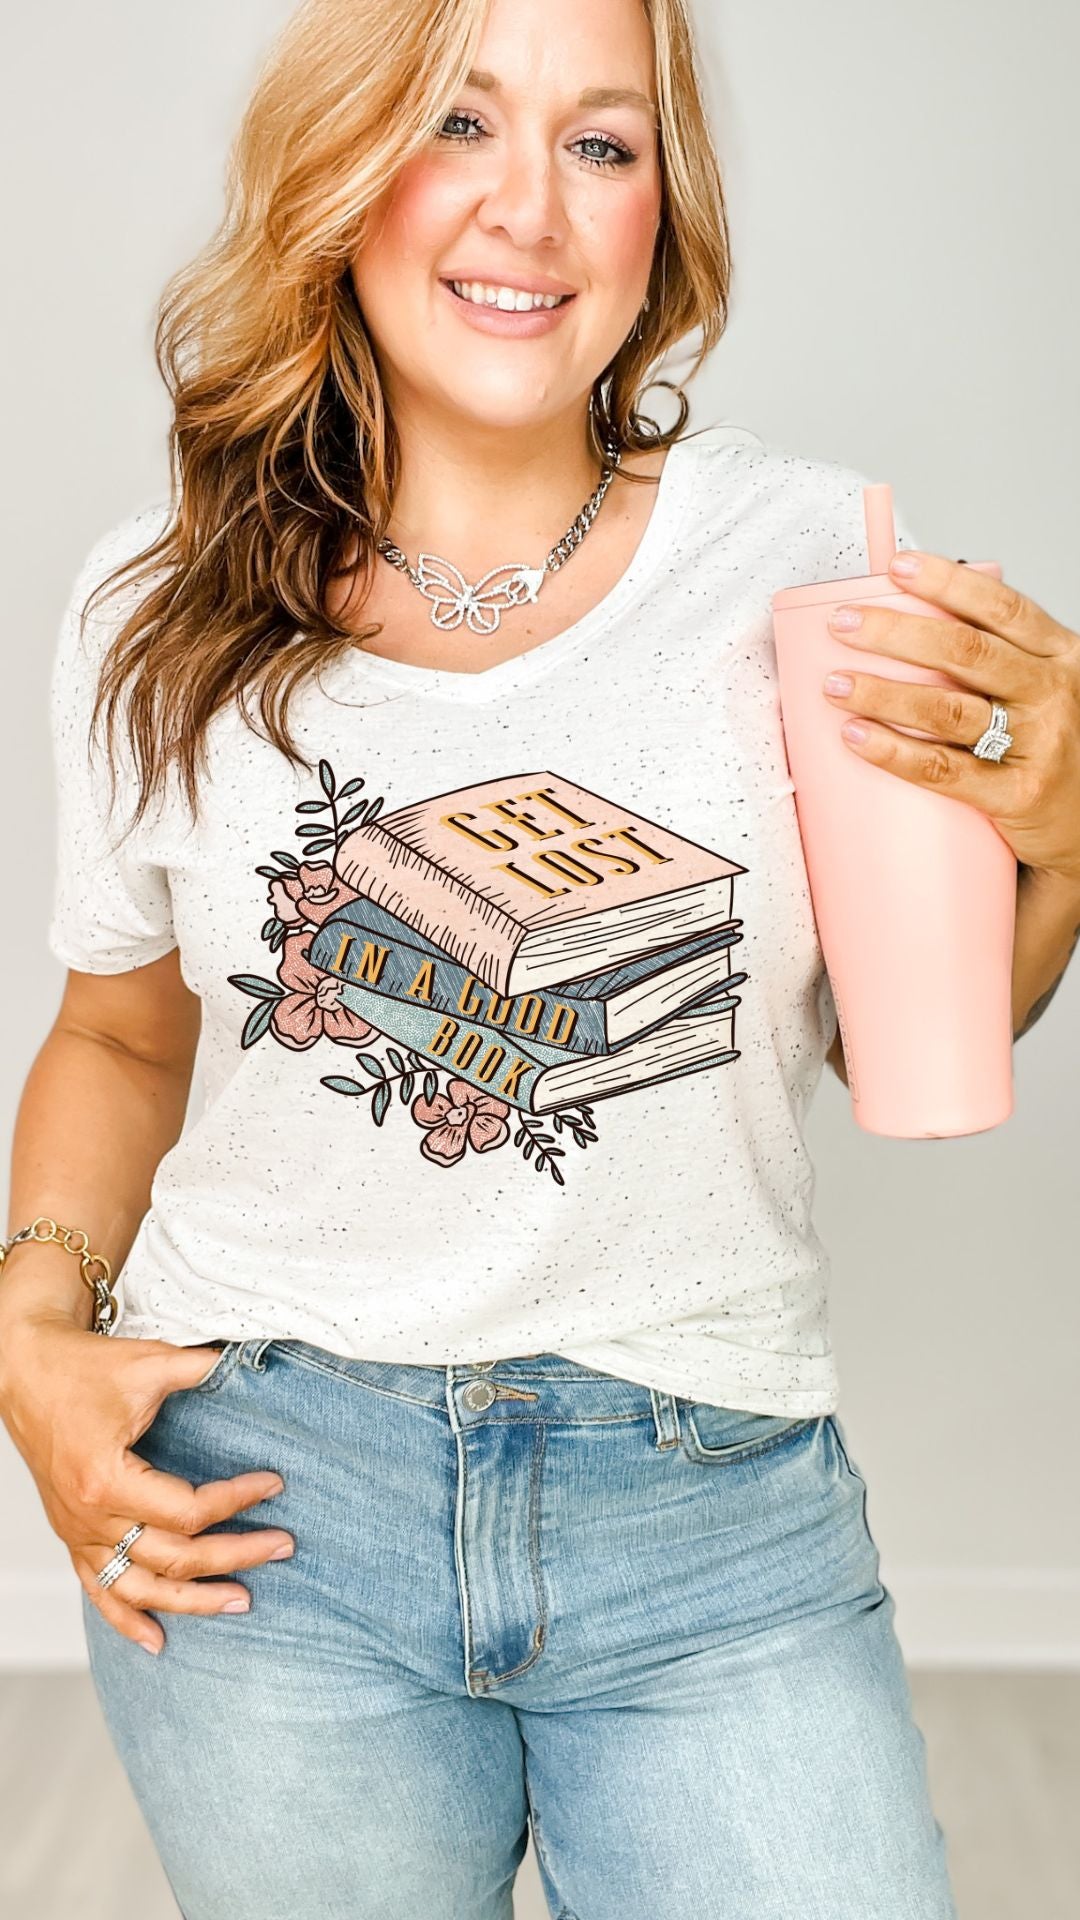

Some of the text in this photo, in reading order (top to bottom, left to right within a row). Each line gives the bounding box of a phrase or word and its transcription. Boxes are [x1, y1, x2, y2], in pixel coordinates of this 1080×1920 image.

[440, 788, 596, 852] GET
[490, 827, 674, 899] LOST
[330, 932, 579, 1045] IN A GOOD
[426, 1016, 536, 1100] BOOK
